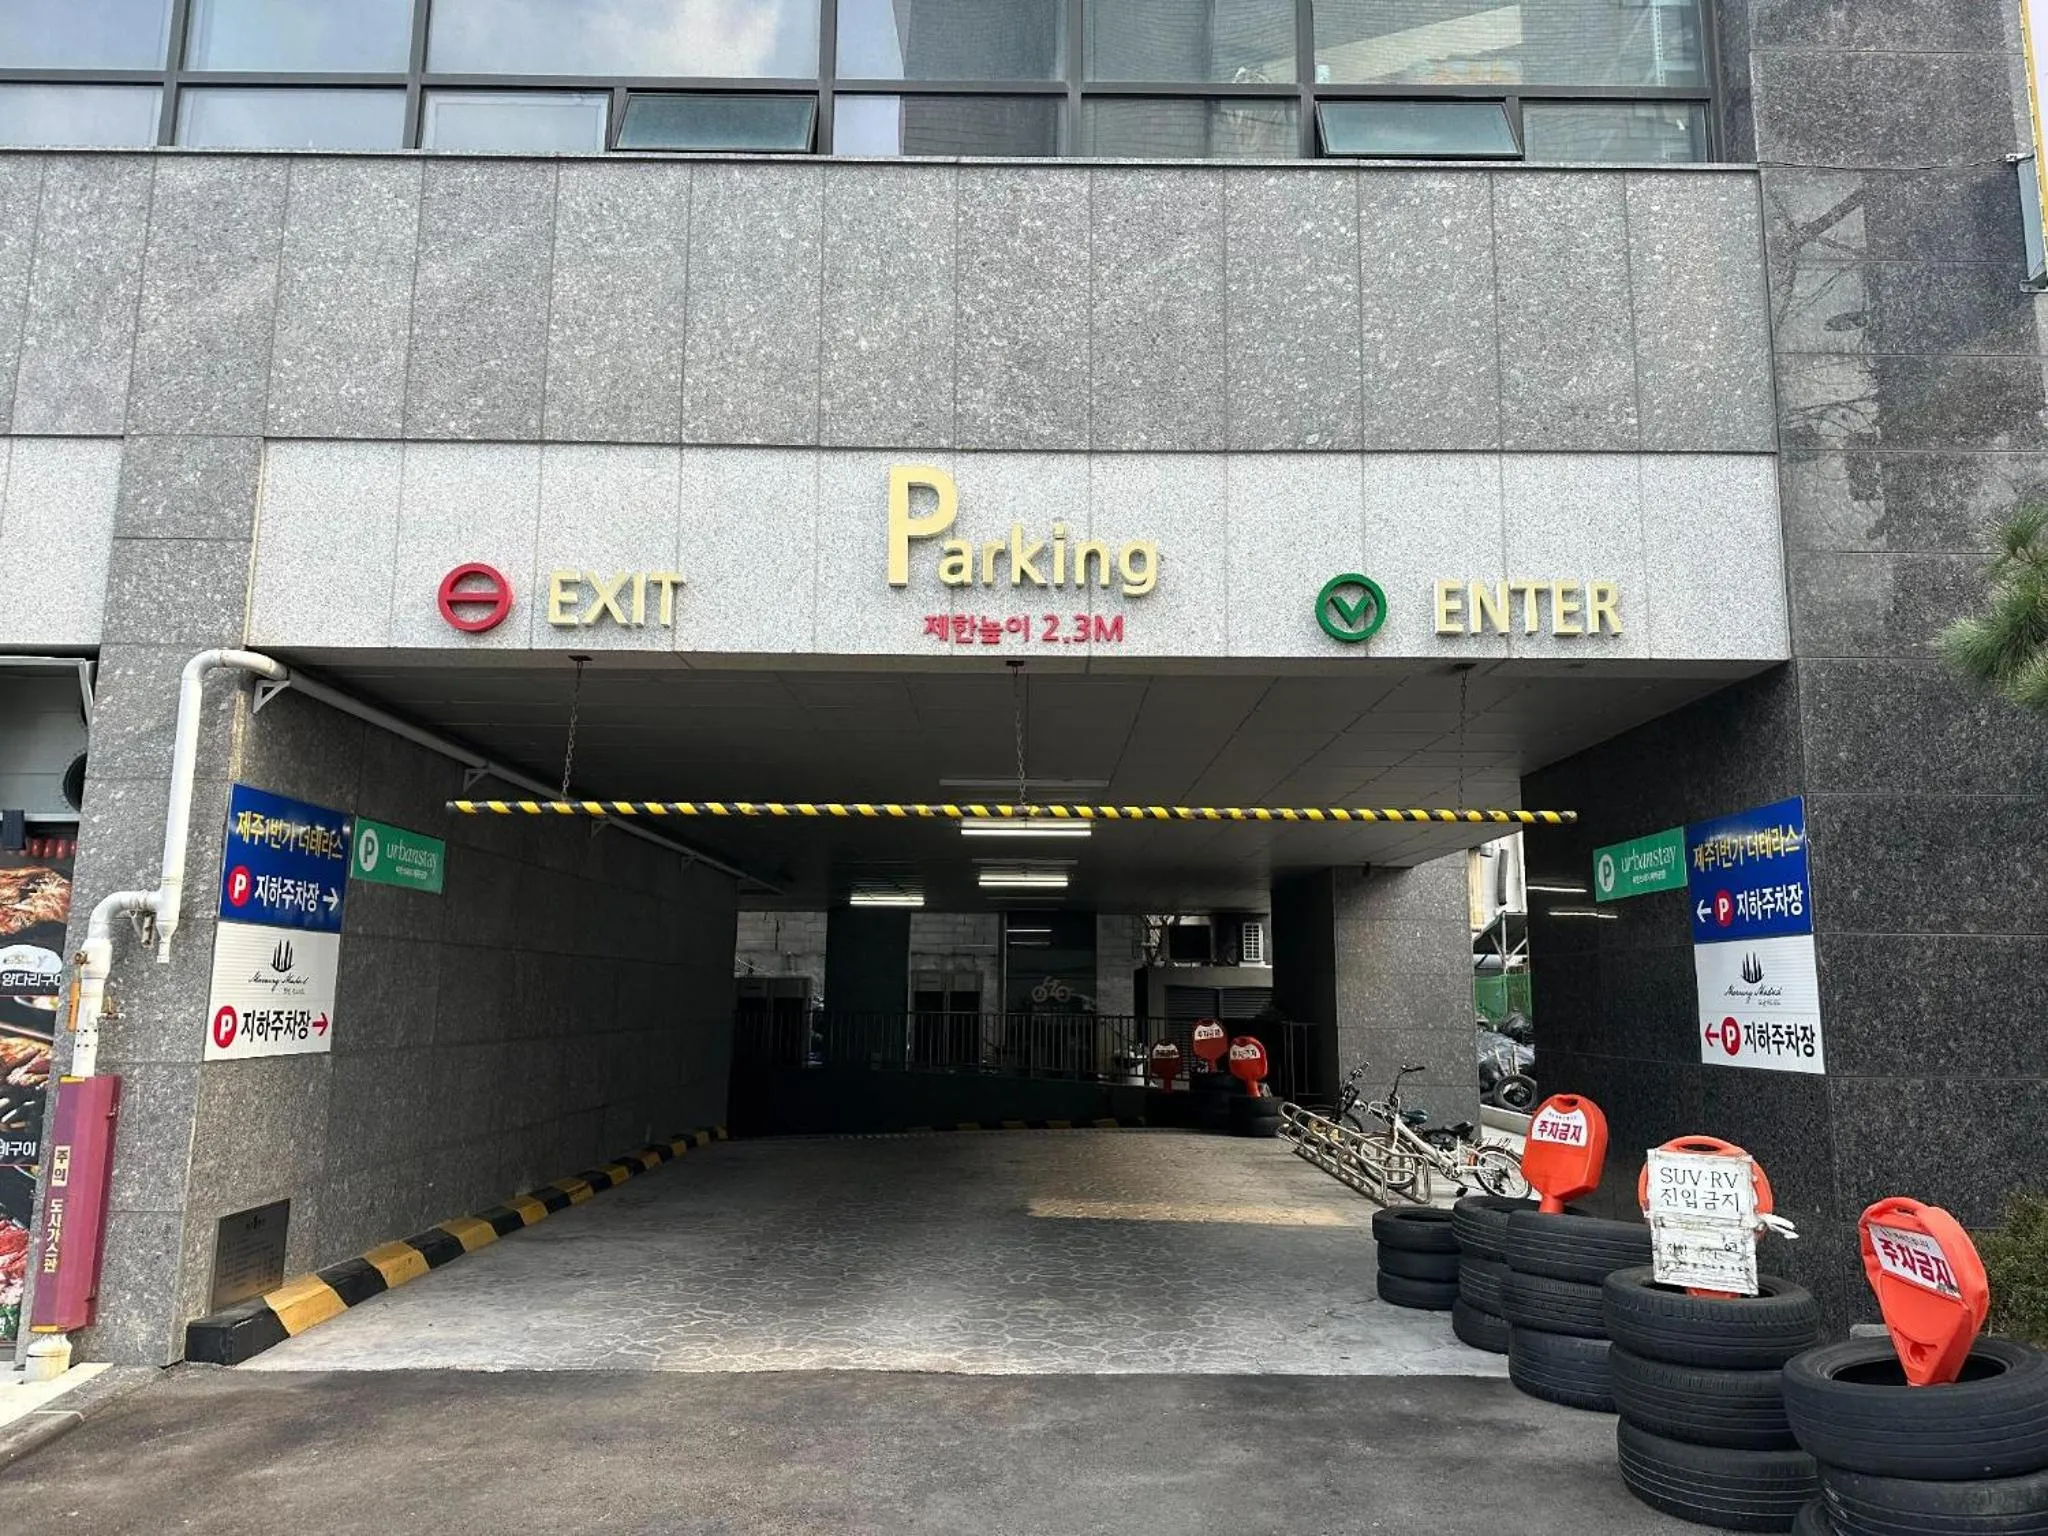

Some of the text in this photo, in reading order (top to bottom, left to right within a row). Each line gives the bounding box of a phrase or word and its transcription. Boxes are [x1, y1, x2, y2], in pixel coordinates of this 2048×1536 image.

[888, 464, 1159, 598] Parking
[549, 569, 685, 628] EXIT
[1433, 578, 1623, 637] ENTER
[923, 613, 1125, 645] 제한높이 2.3M
[298, 824, 344, 860] 더테라스
[387, 839, 438, 873] urbanstay
[1621, 845, 1676, 873] urbanstay
[1693, 824, 1800, 873] 제주1번가 더테라스
[234, 873, 320, 912] P 지하주차장
[1718, 882, 1804, 922] P 지하주차장
[219, 1009, 311, 1042] P 지하주차장
[1725, 1021, 1816, 1058] P 지하주차장
[1538, 1120, 1583, 1143] 주차금지
[1660, 1187, 1740, 1213] 진입금지
[43, 1199, 64, 1274] 도시가스관
[1877, 1237, 1958, 1290] 주차금지
